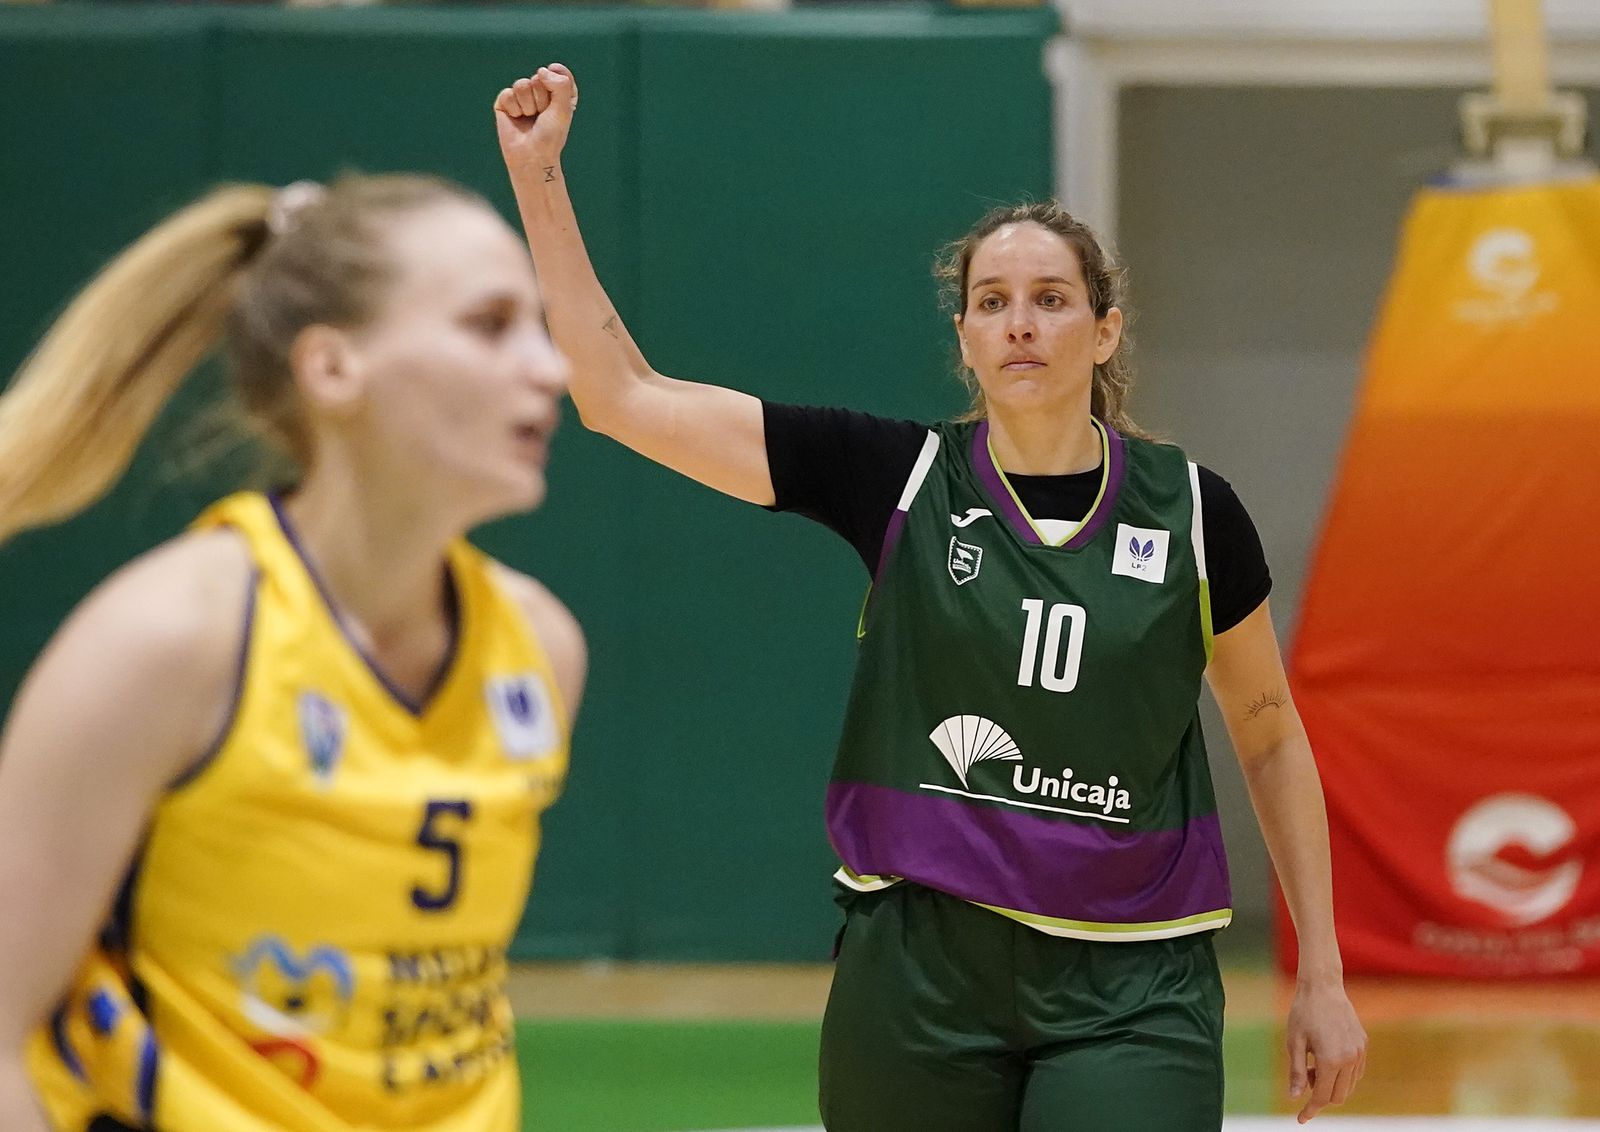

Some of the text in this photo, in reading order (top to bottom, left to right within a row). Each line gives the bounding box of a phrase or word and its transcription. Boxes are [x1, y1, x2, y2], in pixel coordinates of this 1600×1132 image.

[1017, 598, 1087, 693] 10
[1012, 764, 1132, 814] Unicaja
[409, 800, 473, 912] 5
